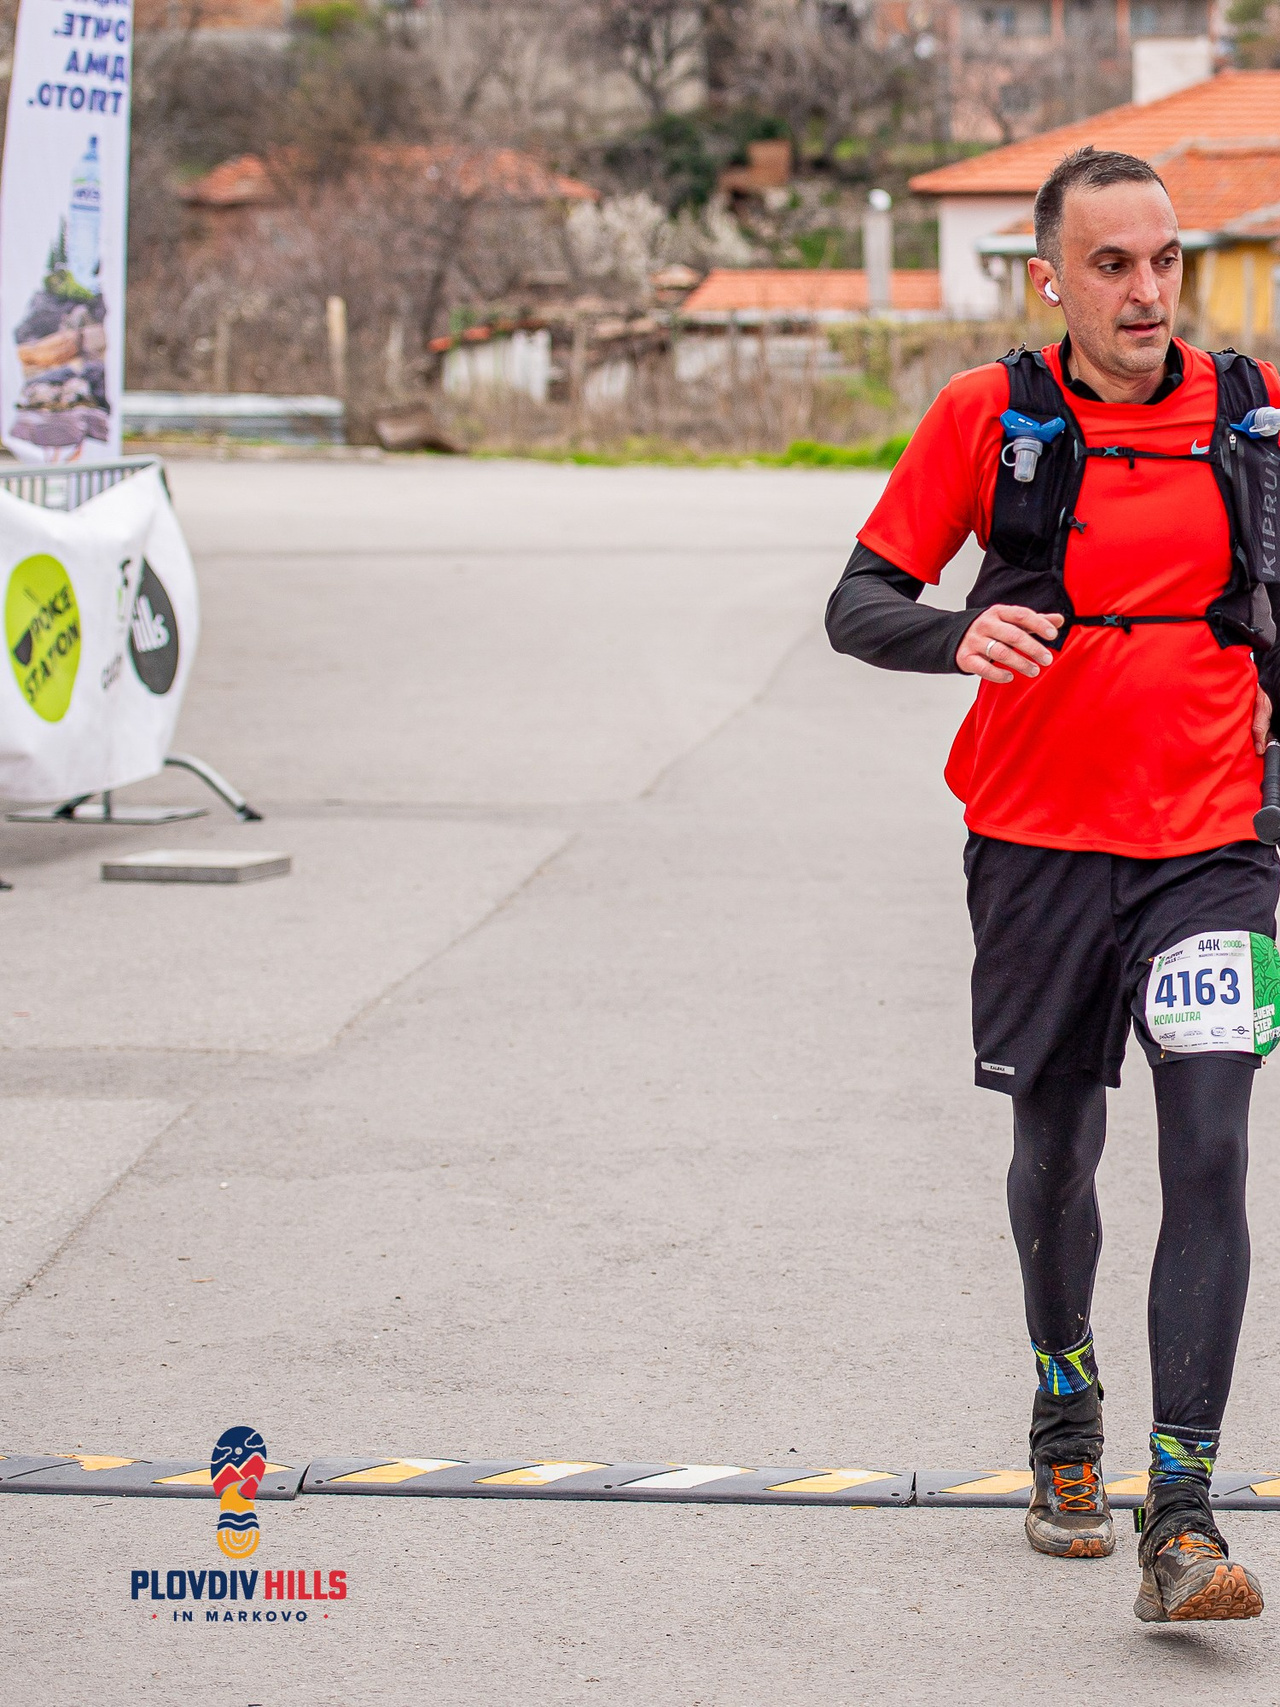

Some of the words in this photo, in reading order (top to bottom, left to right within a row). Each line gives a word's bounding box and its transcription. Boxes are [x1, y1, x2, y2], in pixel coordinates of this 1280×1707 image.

[1198, 938, 1220, 951] 44K
[1154, 967, 1241, 1008] 4163
[1153, 1012, 1174, 1026] KCM
[1175, 1011, 1202, 1023] ULTRA
